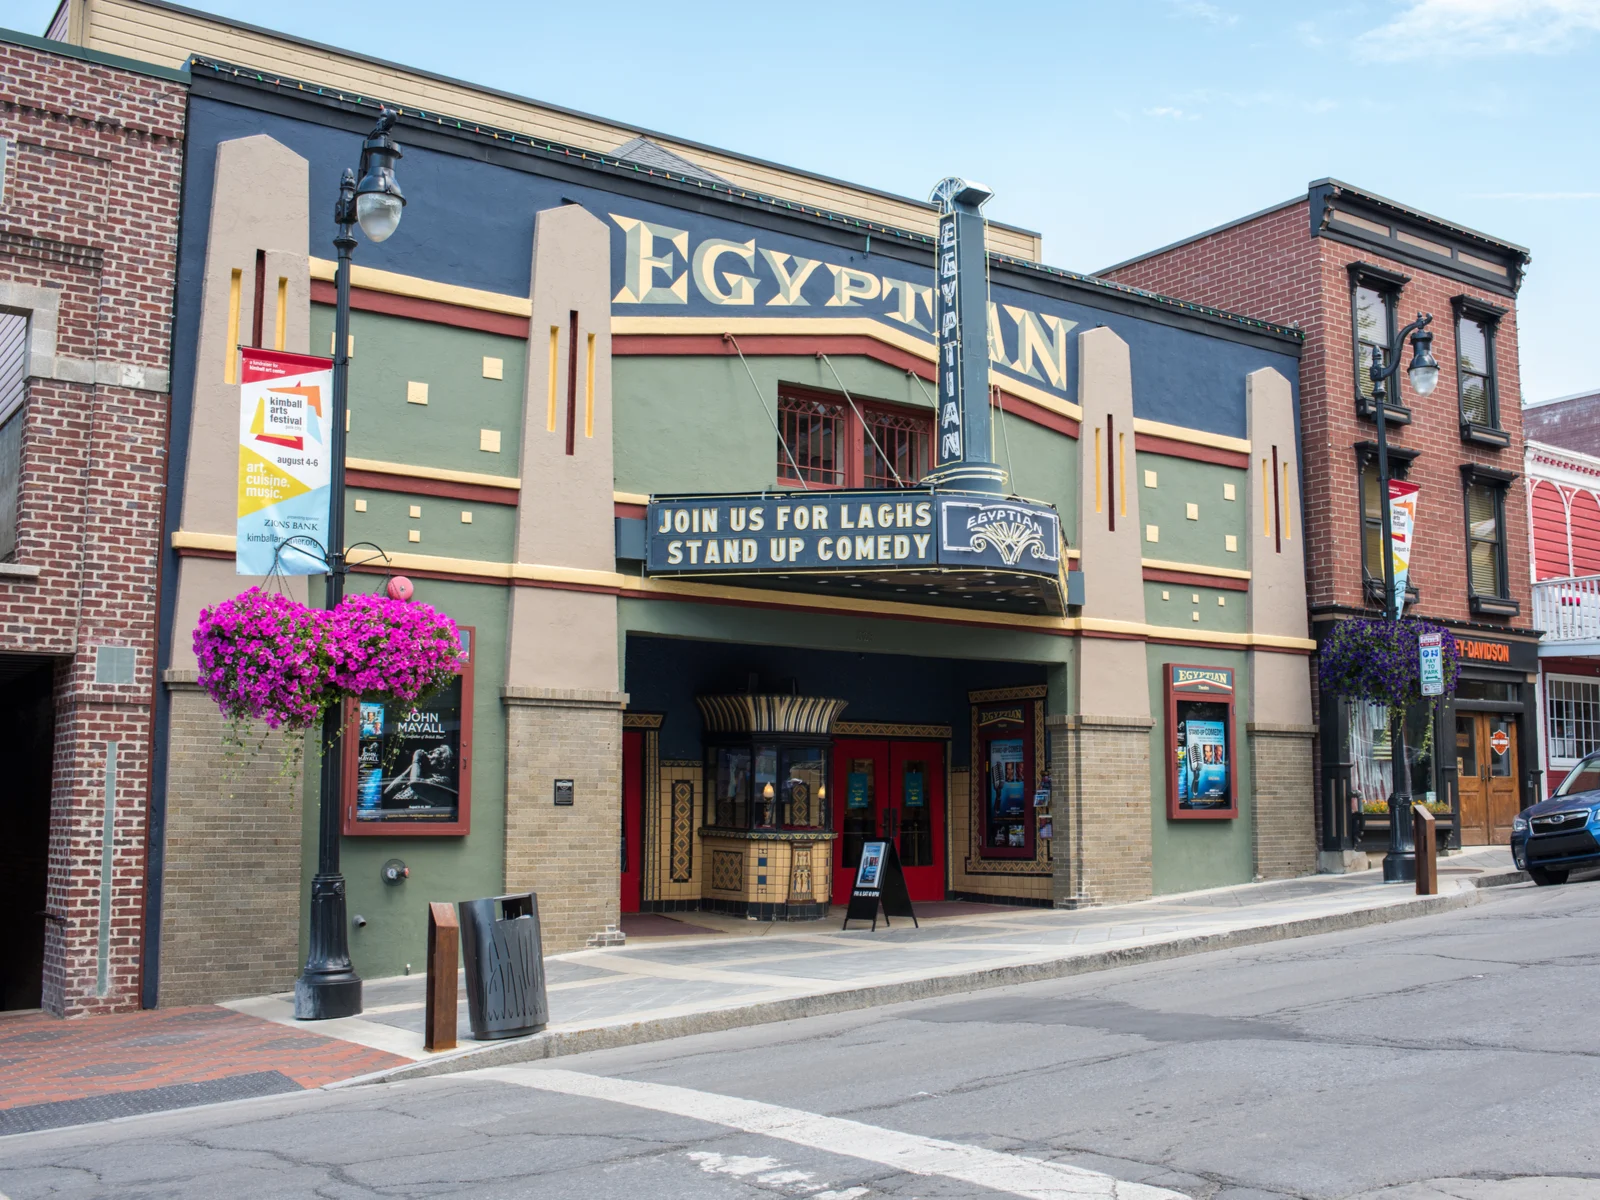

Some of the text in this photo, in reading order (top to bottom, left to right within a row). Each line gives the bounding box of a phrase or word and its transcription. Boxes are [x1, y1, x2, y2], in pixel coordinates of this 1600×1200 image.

[608, 213, 1078, 391] EGYPTAN
[940, 221, 960, 460] EGYPTIAN
[270, 396, 302, 408] kimball
[270, 406, 288, 415] arts
[270, 414, 302, 425] festival
[246, 462, 267, 473] art.
[277, 457, 318, 467] august 4-6
[246, 474, 290, 488] cuisine.
[246, 486, 283, 499] music.
[659, 502, 932, 533] JOIN US FOR LAGHS
[966, 510, 1044, 536] EGYPTIAN
[264, 519, 318, 531] ZIONS BANK
[667, 533, 931, 565] STAND UP COMEDY
[1454, 639, 1509, 662] EY-DAVIDSON
[1178, 669, 1227, 685] EGYPTIAN
[404, 712, 438, 722] JOHN
[981, 709, 1022, 723] EGYPTIAN
[398, 722, 445, 733] MAYALL
